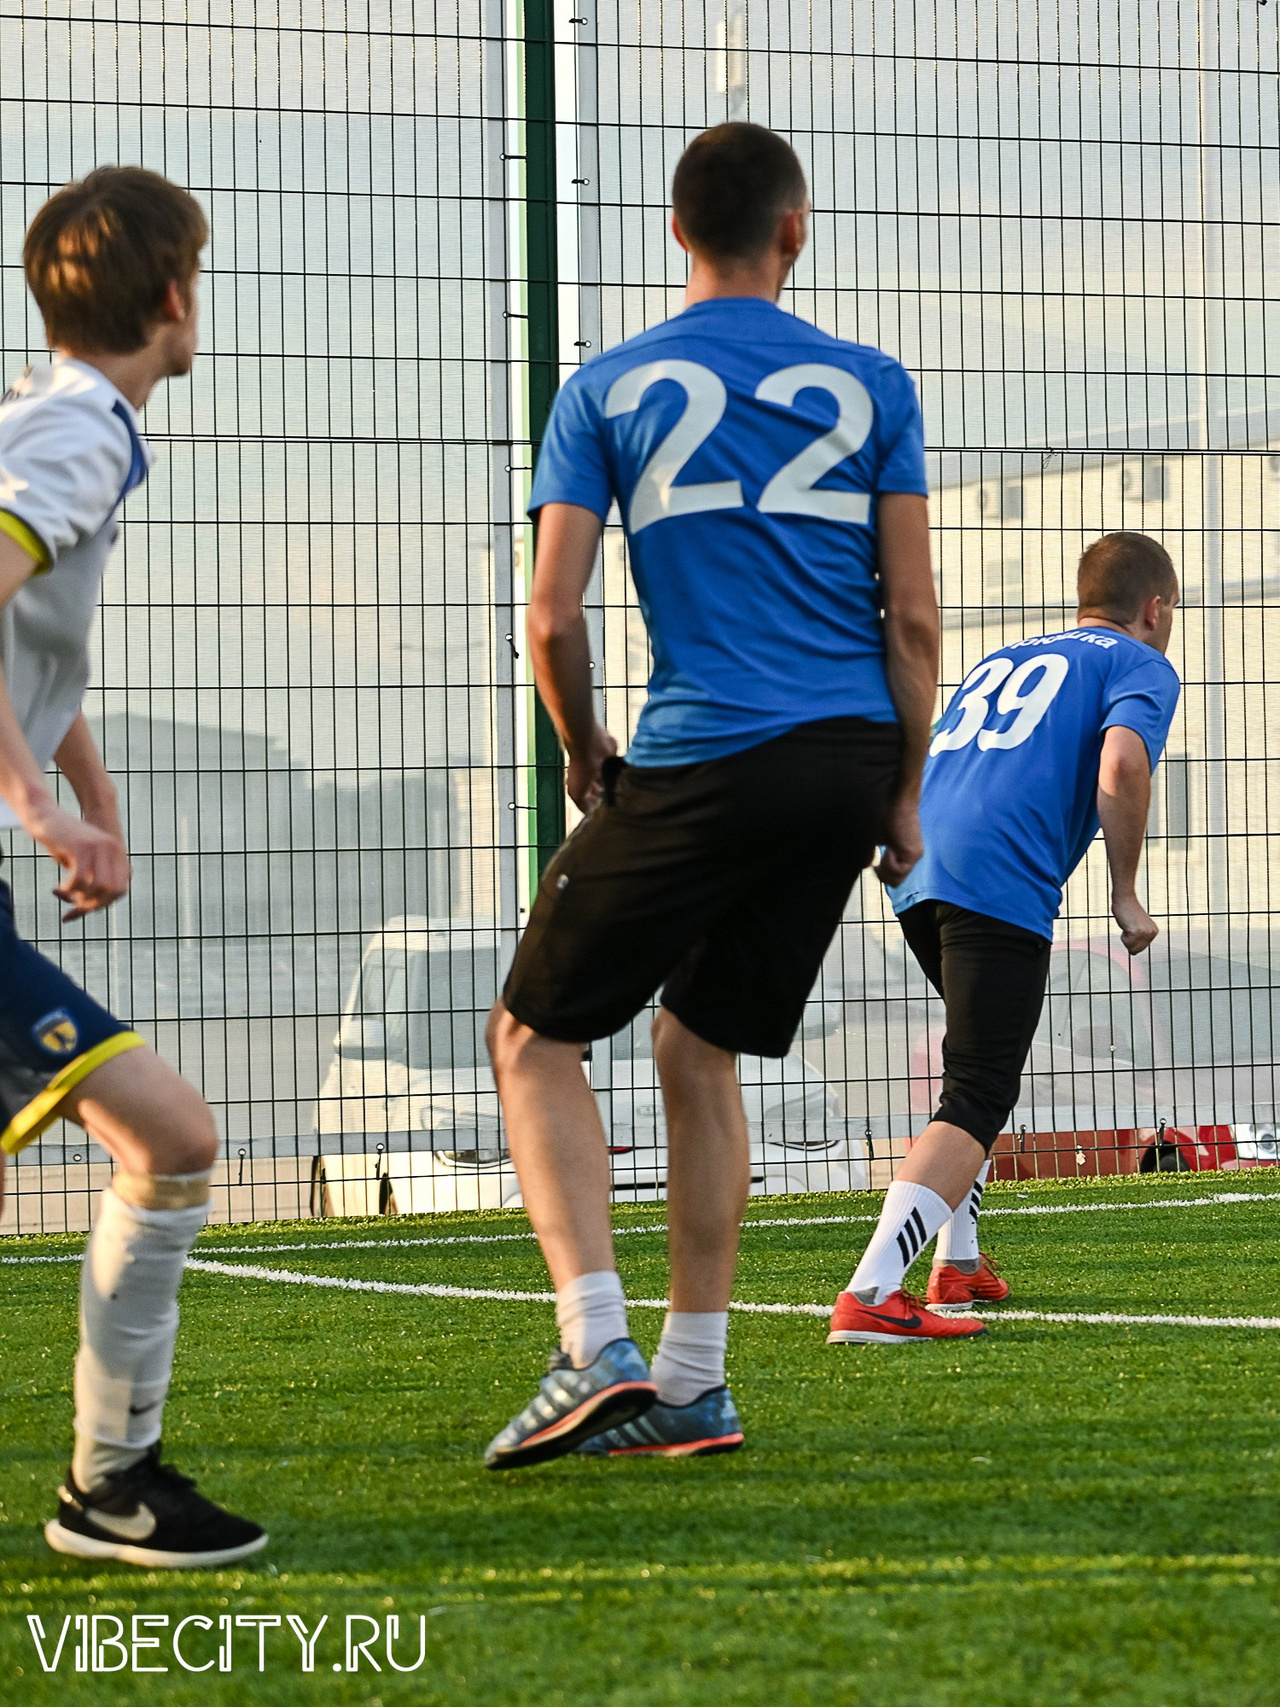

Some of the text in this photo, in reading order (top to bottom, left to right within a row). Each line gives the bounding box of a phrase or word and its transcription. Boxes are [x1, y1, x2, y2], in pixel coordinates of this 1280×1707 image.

[604, 359, 874, 535] 22
[1010, 630, 1118, 649] рюшка
[929, 653, 1069, 757] 39
